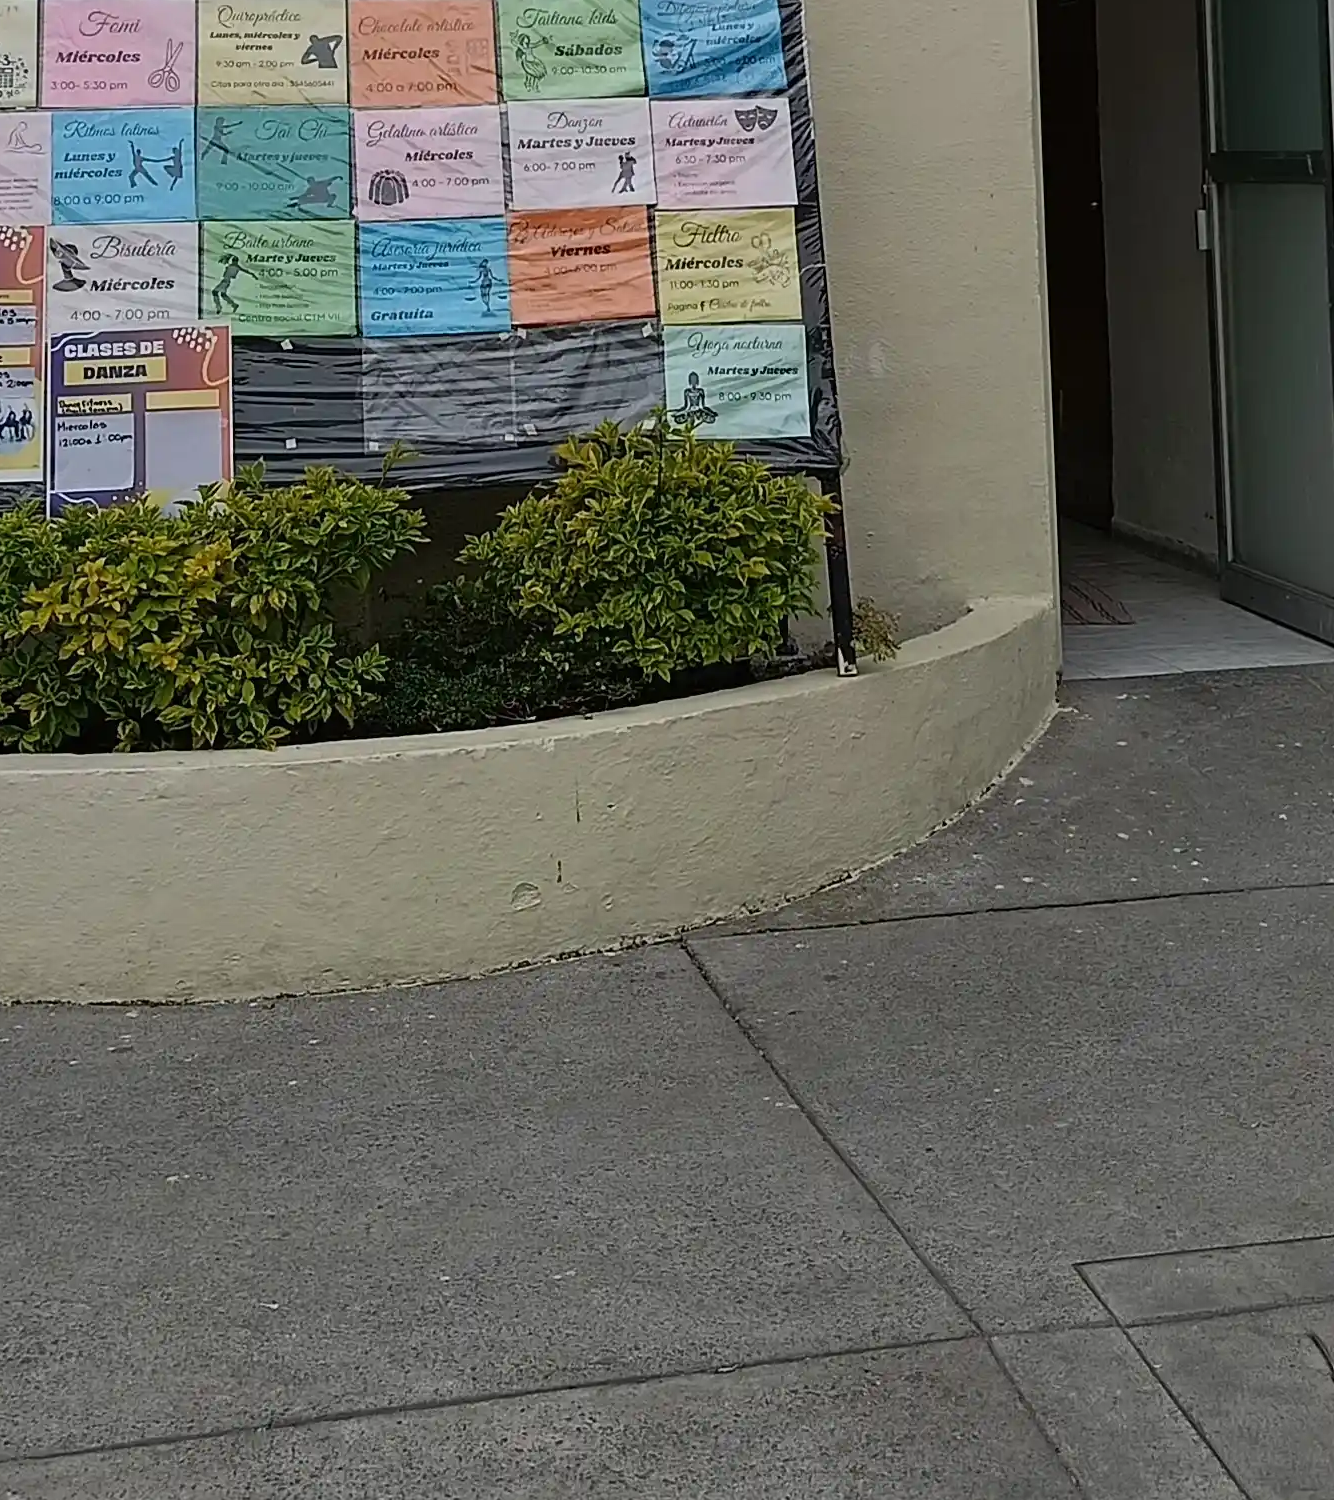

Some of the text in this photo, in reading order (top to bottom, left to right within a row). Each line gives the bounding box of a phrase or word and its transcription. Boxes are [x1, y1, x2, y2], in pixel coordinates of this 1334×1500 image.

[209, 30, 301, 41] Lunes, miércoles y
[235, 42, 273, 51] viernes
[554, 43, 623, 57] Sábados
[55, 49, 142, 65] Miércoles
[363, 47, 441, 61] Miércoles
[609, 65, 627, 74] am
[82, 80, 128, 92] 5:30 pm
[395, 84, 404, 92] a
[436, 82, 459, 94] pm
[517, 135, 636, 150] Martes y Jueves
[665, 137, 755, 149] Martes y Jueves
[63, 151, 116, 164] Lunes y
[236, 151, 329, 164] Martes y jueves
[404, 149, 474, 162] Miércoles
[728, 155, 747, 165] pm
[578, 161, 596, 173] pm
[54, 167, 123, 180] miércoles
[471, 177, 490, 189] pm
[83, 196, 93, 205] a
[94, 194, 122, 205] 9:00
[123, 194, 145, 206] pm
[89, 235, 176, 260] Bisutería
[245, 253, 337, 265] Marte y Jueves
[665, 256, 744, 271] Miércoles
[320, 267, 339, 279] pm
[372, 261, 449, 273] Martes y Jueves
[89, 277, 175, 292] Miércoles
[425, 285, 443, 295] pm
[721, 280, 740, 290] pm
[70, 309, 170, 323] 4:00 7:00 pm
[239, 312, 272, 323] Centro
[371, 308, 435, 322] Gratuita
[63, 340, 165, 358] CLASES DE
[687, 331, 784, 359] Yoga nocturna
[83, 364, 148, 380] DANZA
[707, 365, 799, 377] Martes y Jueves
[773, 391, 792, 402] pm
